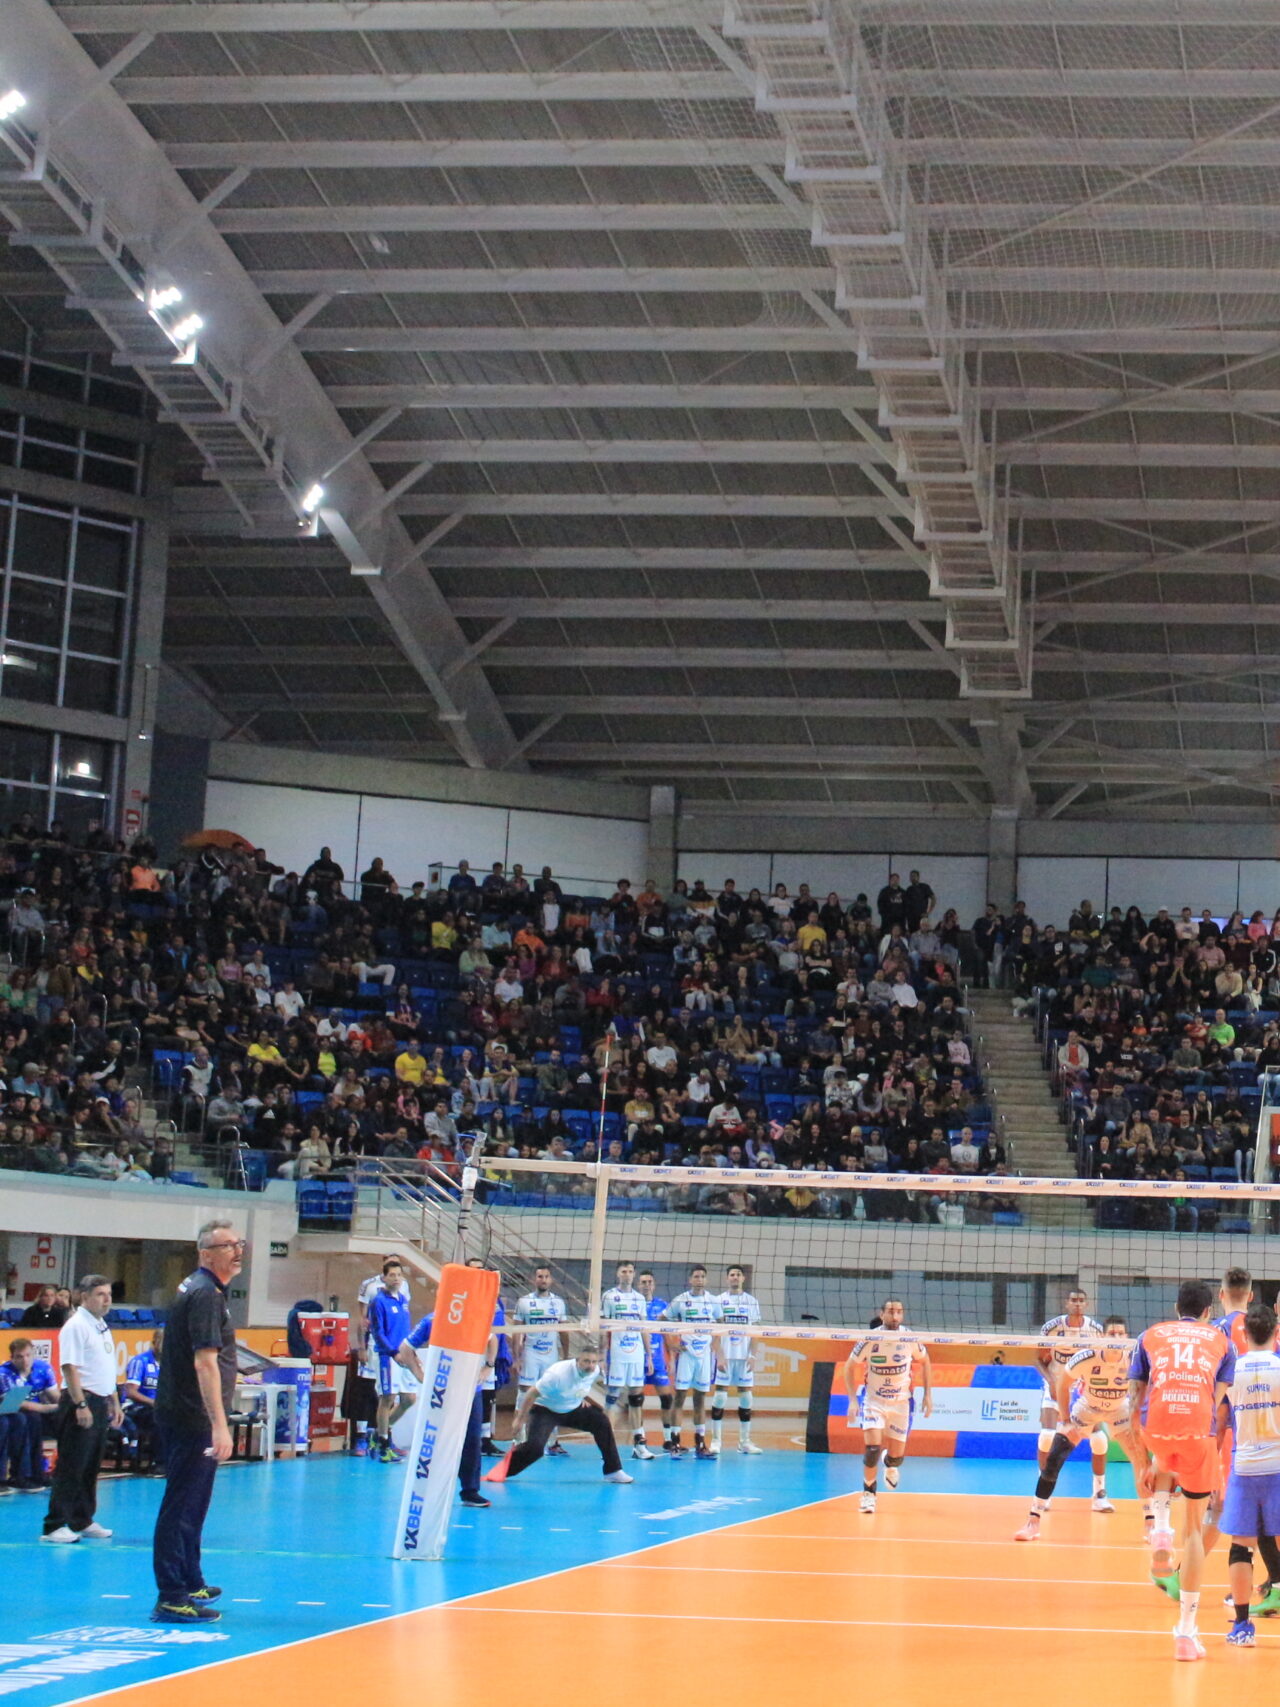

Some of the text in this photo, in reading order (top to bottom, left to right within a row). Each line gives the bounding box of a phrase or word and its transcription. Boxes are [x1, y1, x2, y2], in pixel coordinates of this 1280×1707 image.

[448, 1291, 467, 1324] GOL
[431, 1350, 453, 1409] 1XBET
[1171, 1344, 1195, 1369] 14
[416, 1420, 438, 1479] 1XBET
[404, 1491, 425, 1550] 1XBET
